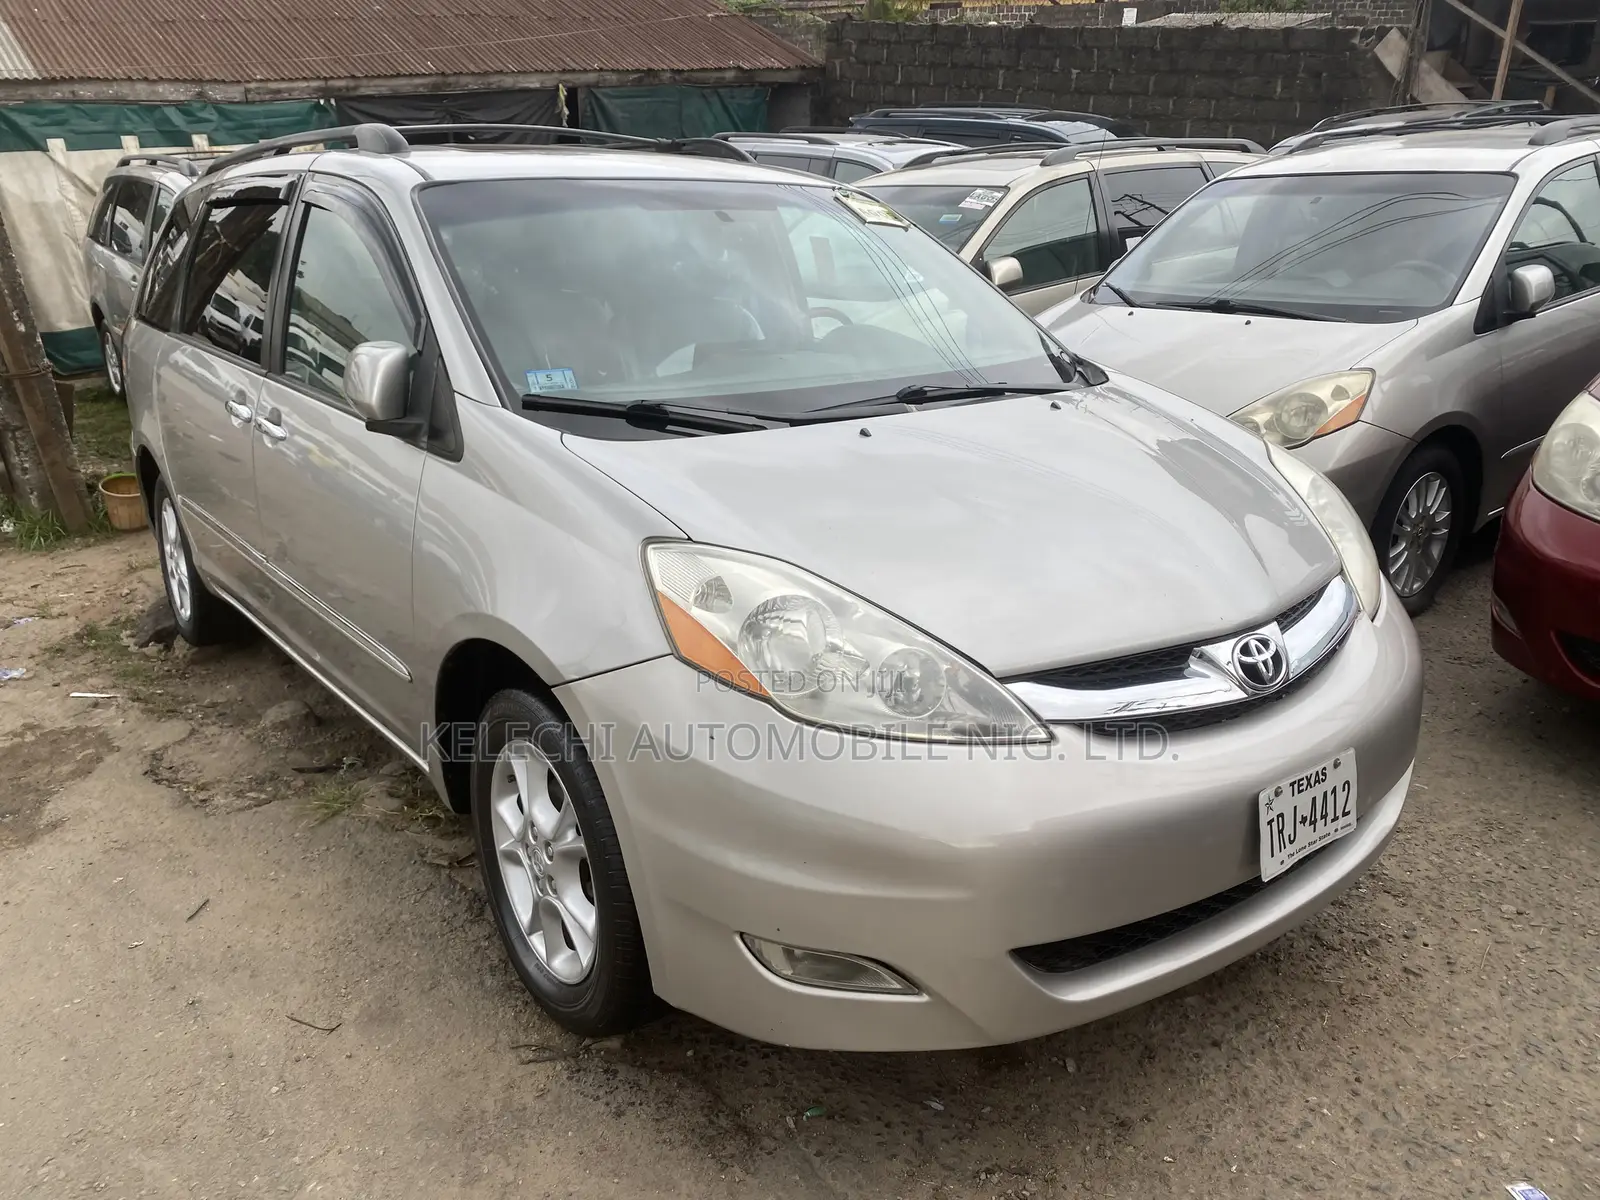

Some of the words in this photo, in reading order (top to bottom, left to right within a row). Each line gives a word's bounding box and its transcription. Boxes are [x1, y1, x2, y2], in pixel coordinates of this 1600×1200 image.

[1289, 766, 1327, 797] TEXAS
[1287, 851, 1295, 859] The
[1295, 844, 1307, 855] Lone
[1307, 839, 1318, 848] Star
[1318, 832, 1331, 842] State
